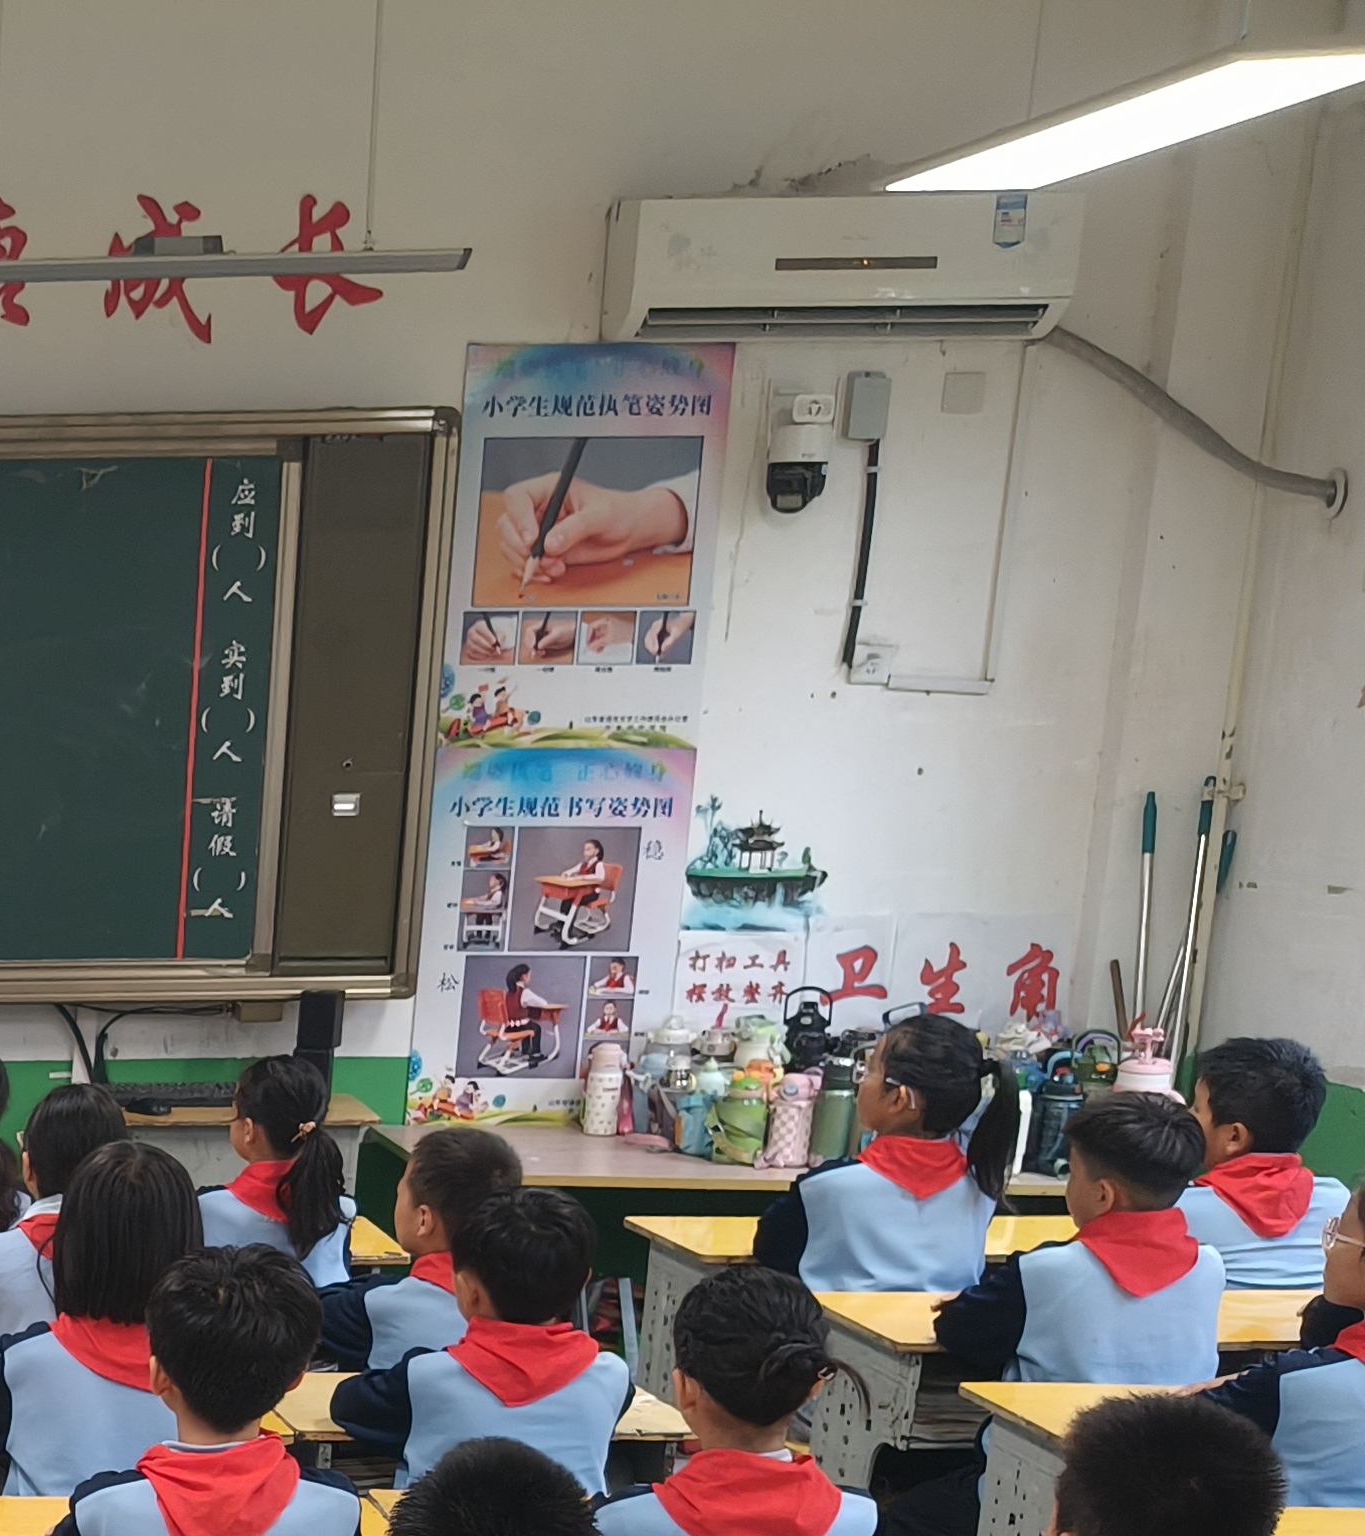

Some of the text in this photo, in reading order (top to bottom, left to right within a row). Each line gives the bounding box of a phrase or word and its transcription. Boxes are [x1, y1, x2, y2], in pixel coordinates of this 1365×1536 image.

[481, 392, 713, 419] 小学生规范执笔姿势图
[449, 795, 673, 818] 小学生规范书写姿势图
[688, 949, 791, 973] 打扫工具
[820, 941, 1060, 1023] 卫生角
